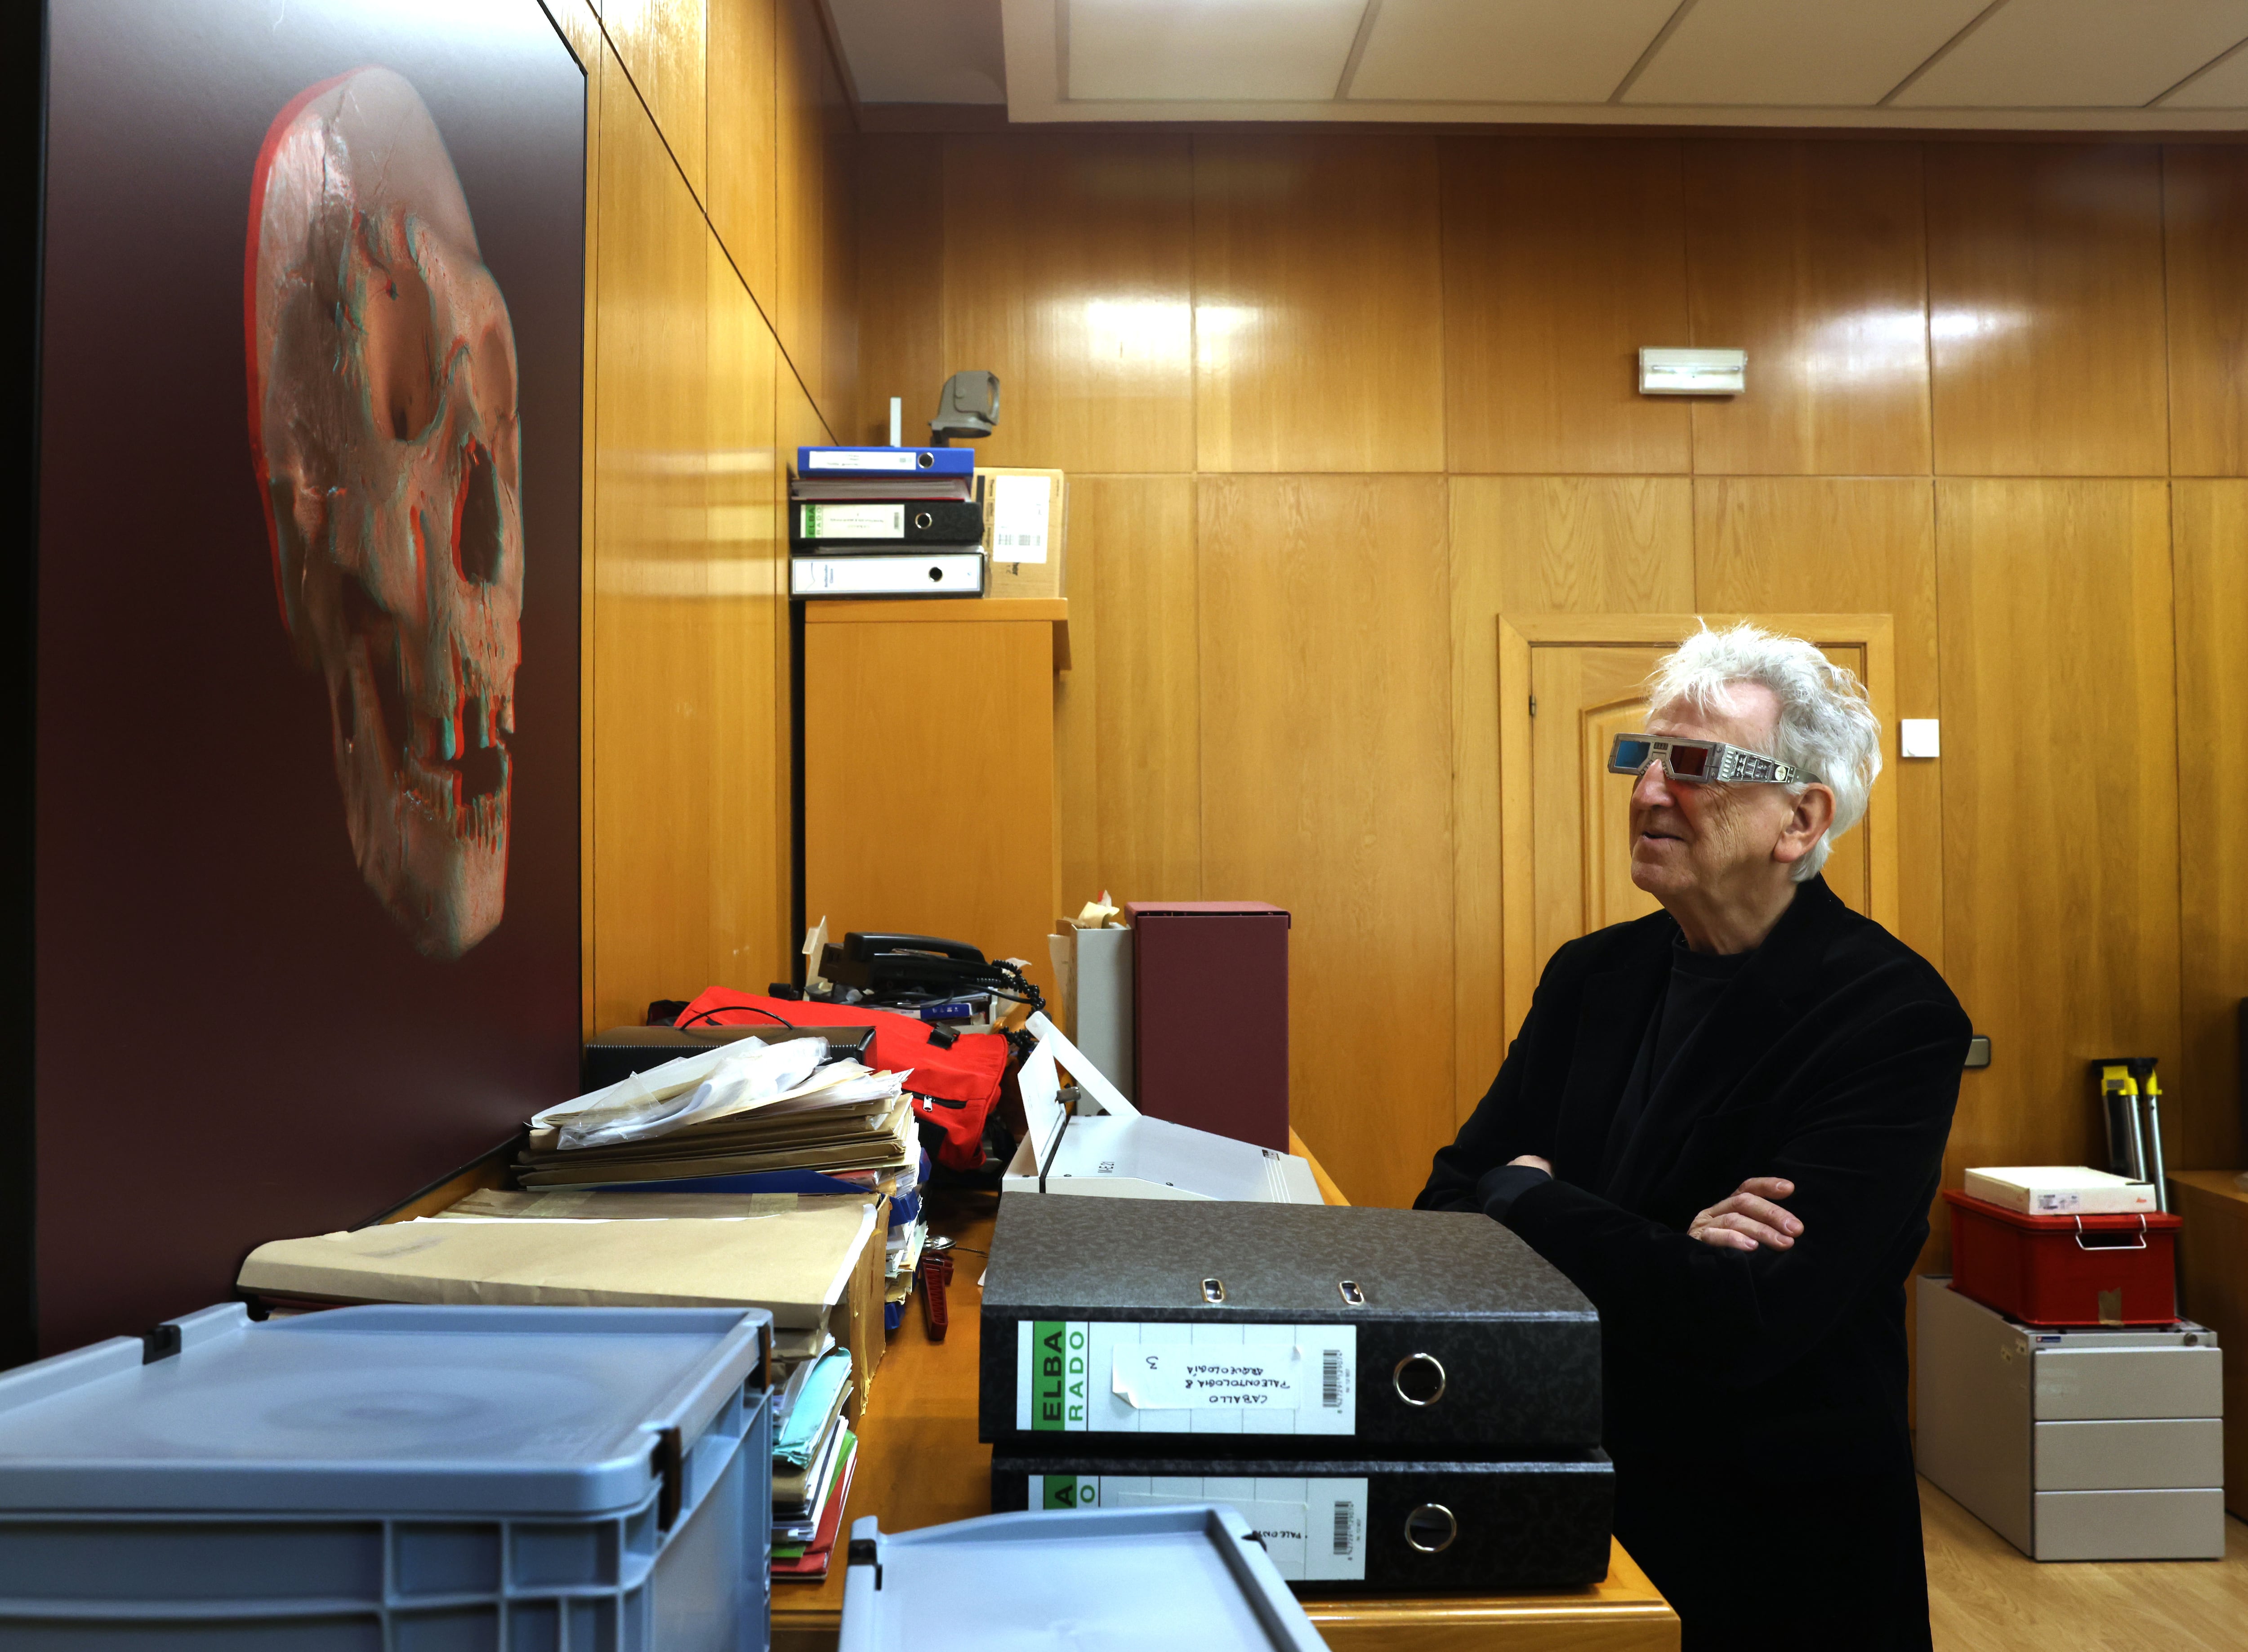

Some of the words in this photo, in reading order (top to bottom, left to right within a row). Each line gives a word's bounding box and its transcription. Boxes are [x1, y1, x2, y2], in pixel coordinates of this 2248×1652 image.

[1043, 1331, 1062, 1421] ELBA
[1068, 1331, 1084, 1421] RADO
[1146, 1356, 1159, 1370] 3
[1209, 1394, 1267, 1403] CABALLO
